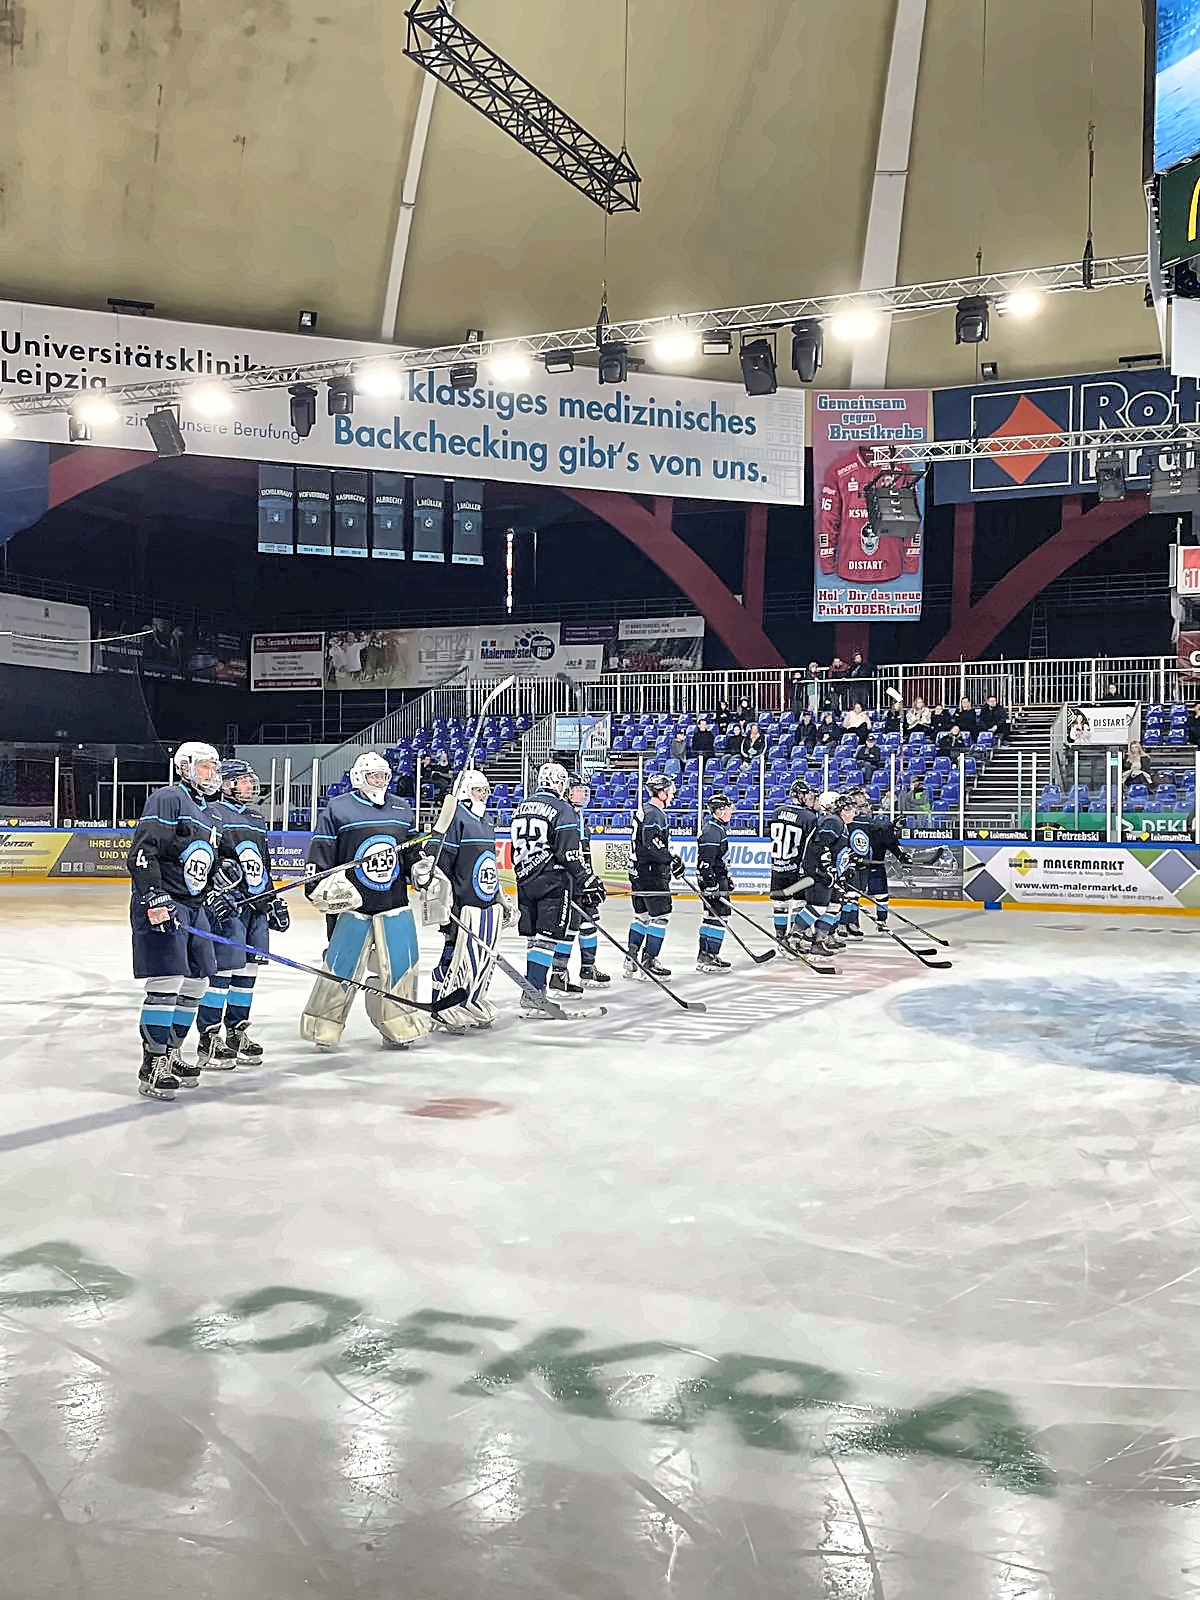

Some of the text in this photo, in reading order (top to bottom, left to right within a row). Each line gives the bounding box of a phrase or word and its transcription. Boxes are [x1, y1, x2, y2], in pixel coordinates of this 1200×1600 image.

[817, 395, 906, 411] Gemeinsam
[559, 391, 757, 436] medizinisches
[842, 413, 876, 424] gegen
[828, 424, 923, 441] Brustkrebs
[334, 414, 548, 473] Backchecking
[649, 452, 701, 478] von
[711, 457, 768, 484] uns.
[848, 560, 884, 570] DISTART
[848, 590, 867, 601] Dir
[871, 590, 891, 601] das
[894, 590, 921, 600] neue
[1093, 717, 1125, 727] DISTART
[209, 825, 219, 848] A
[771, 823, 803, 861] 80
[89, 840, 110, 848] IHRE
[99, 851, 119, 859] UND
[136, 849, 148, 869] 4
[278, 859, 291, 867] Co.
[1043, 859, 1125, 871] MALERMARKT
[1014, 881, 1138, 893] www.wm-malermarkt.de
